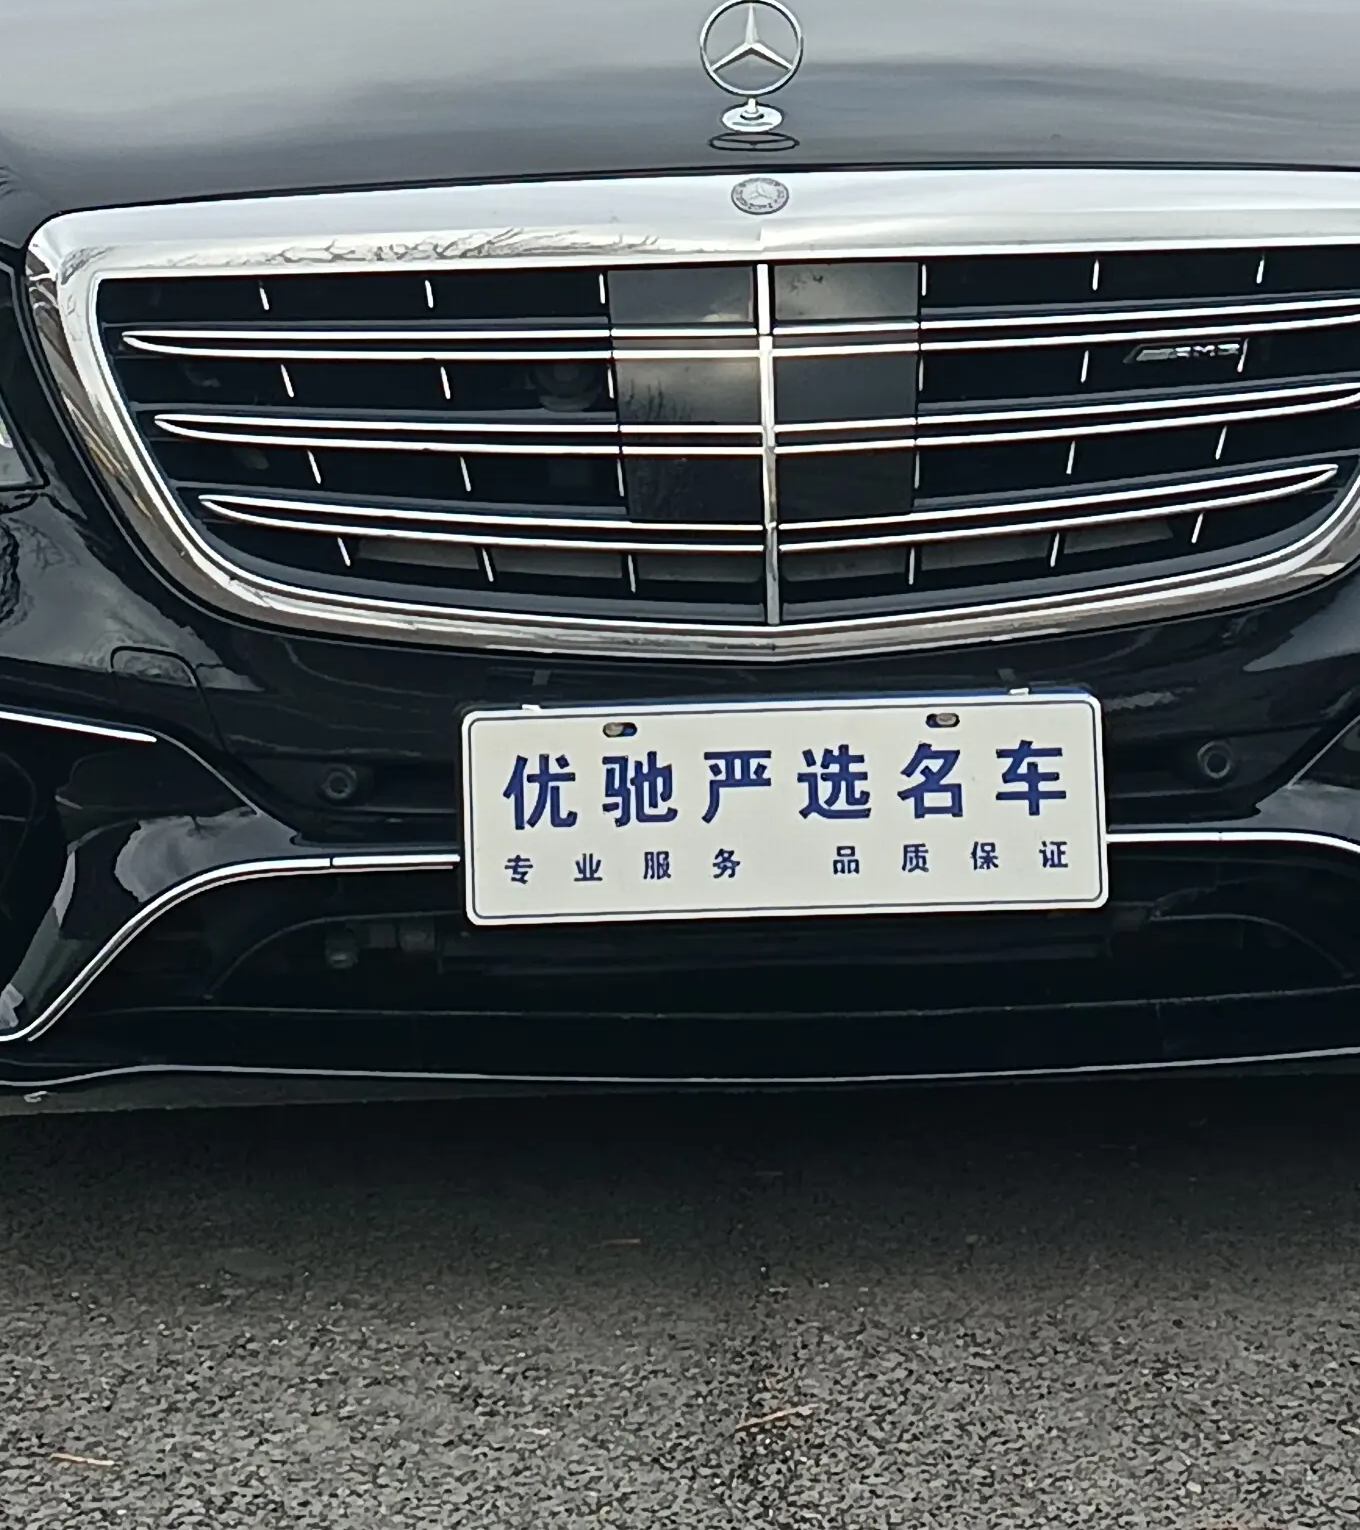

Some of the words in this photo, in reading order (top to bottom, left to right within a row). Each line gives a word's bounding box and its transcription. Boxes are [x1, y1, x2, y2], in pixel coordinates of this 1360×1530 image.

[502, 739, 1068, 831] 优驰严选名车
[503, 846, 742, 886] 专业服务
[831, 839, 1070, 875] 品质保证
